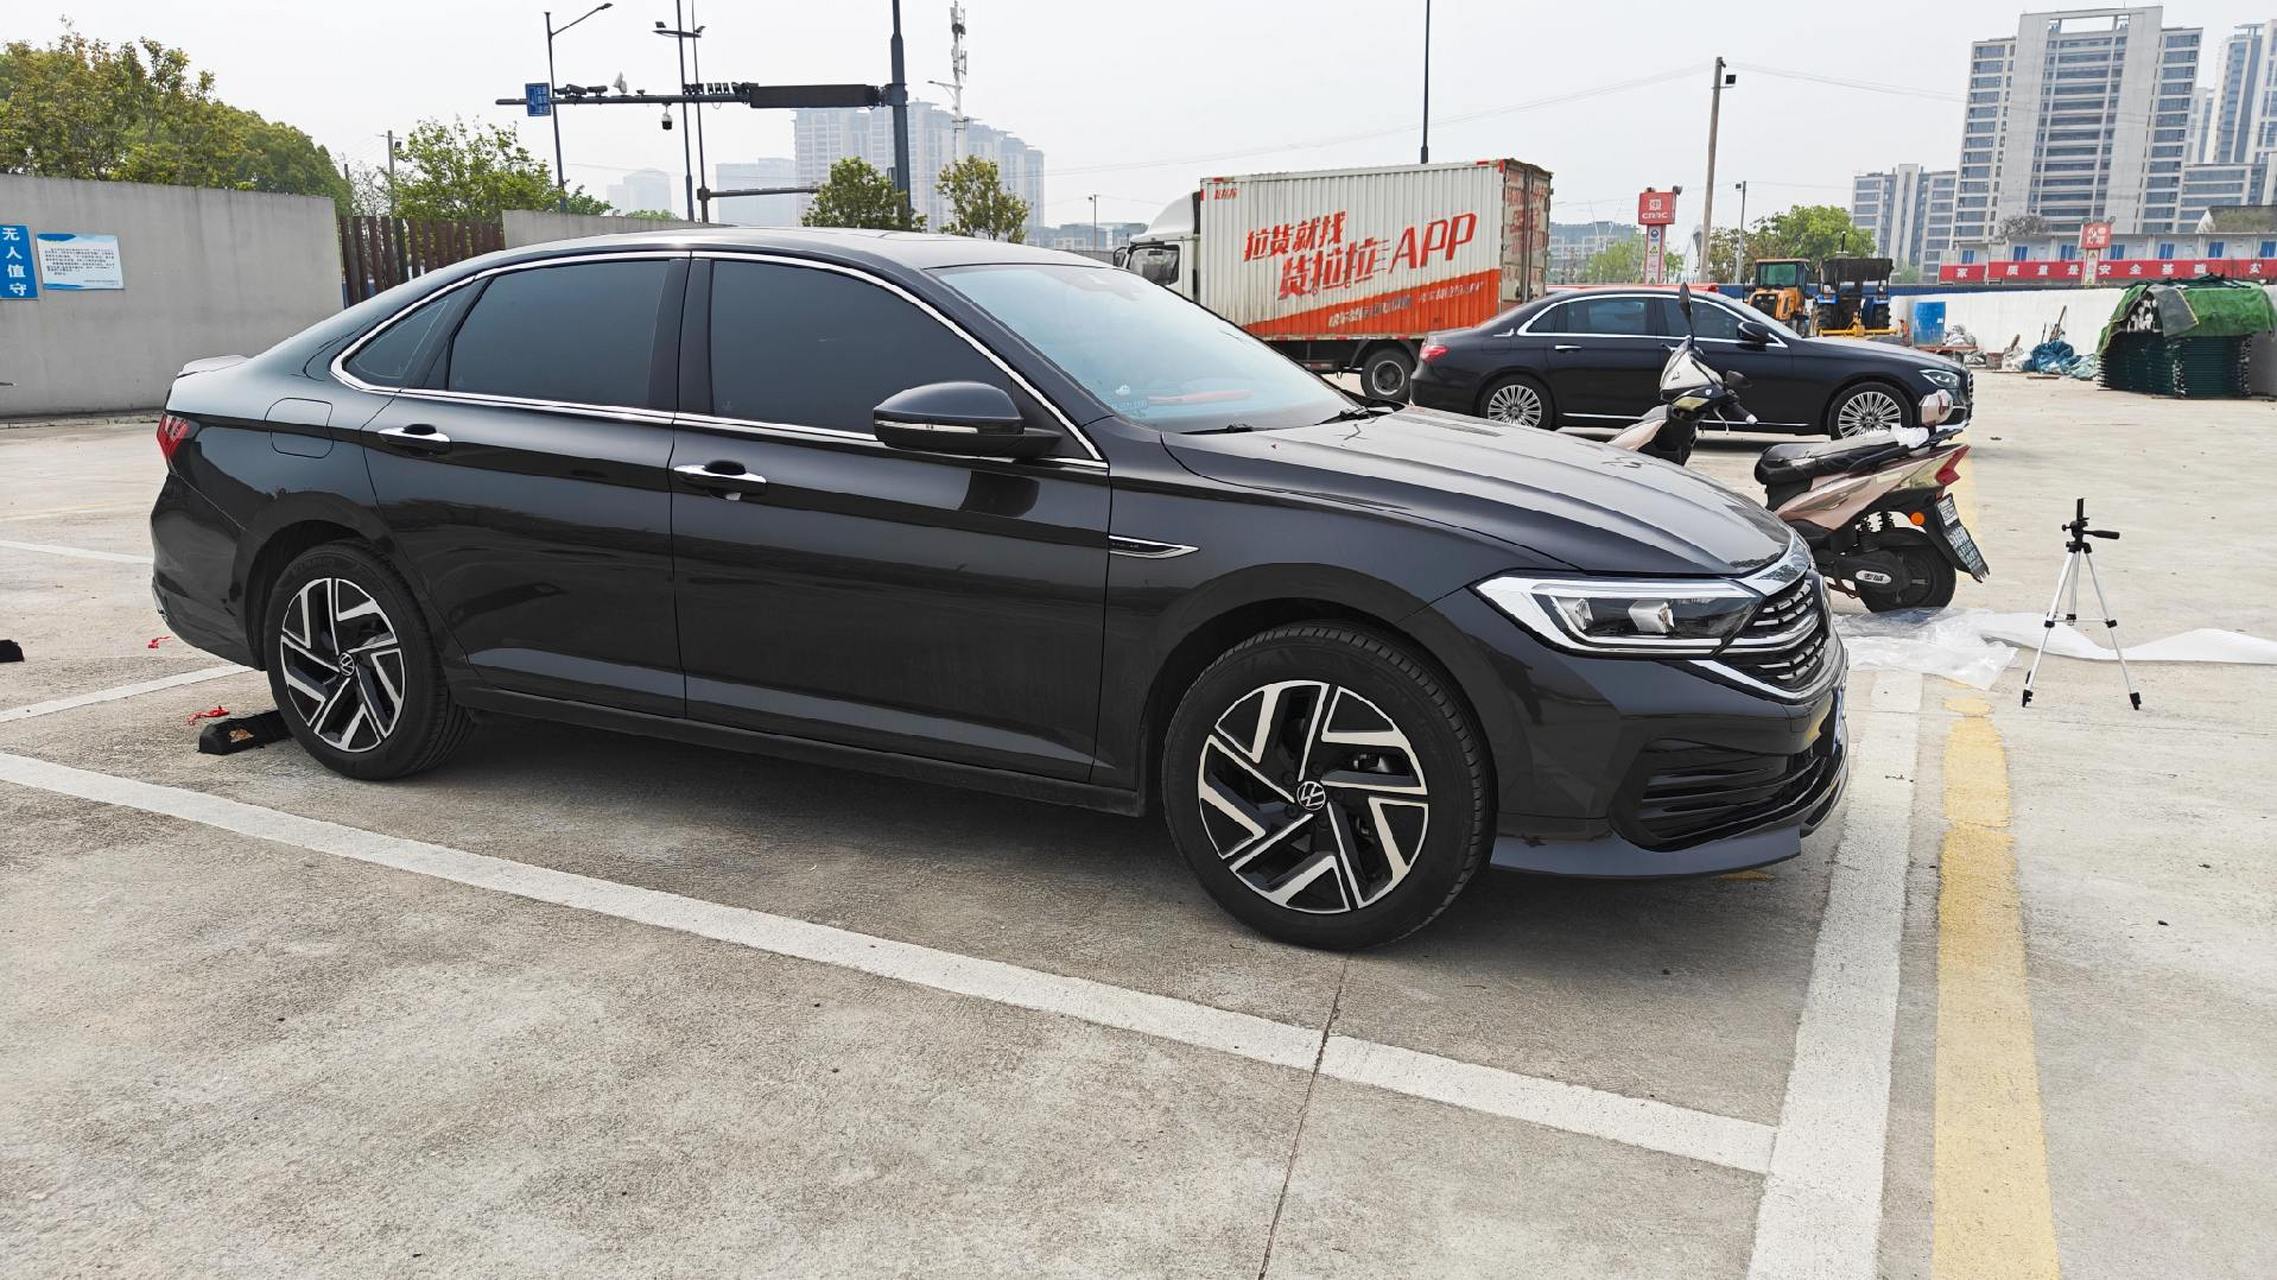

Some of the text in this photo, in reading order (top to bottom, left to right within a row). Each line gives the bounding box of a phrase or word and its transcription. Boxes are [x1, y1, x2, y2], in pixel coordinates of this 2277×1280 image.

[1, 227, 27, 297] 无人值守
[1244, 210, 1347, 262] 拉货就找
[1277, 237, 1380, 300] 货拉拉
[1387, 212, 1477, 274] APP
